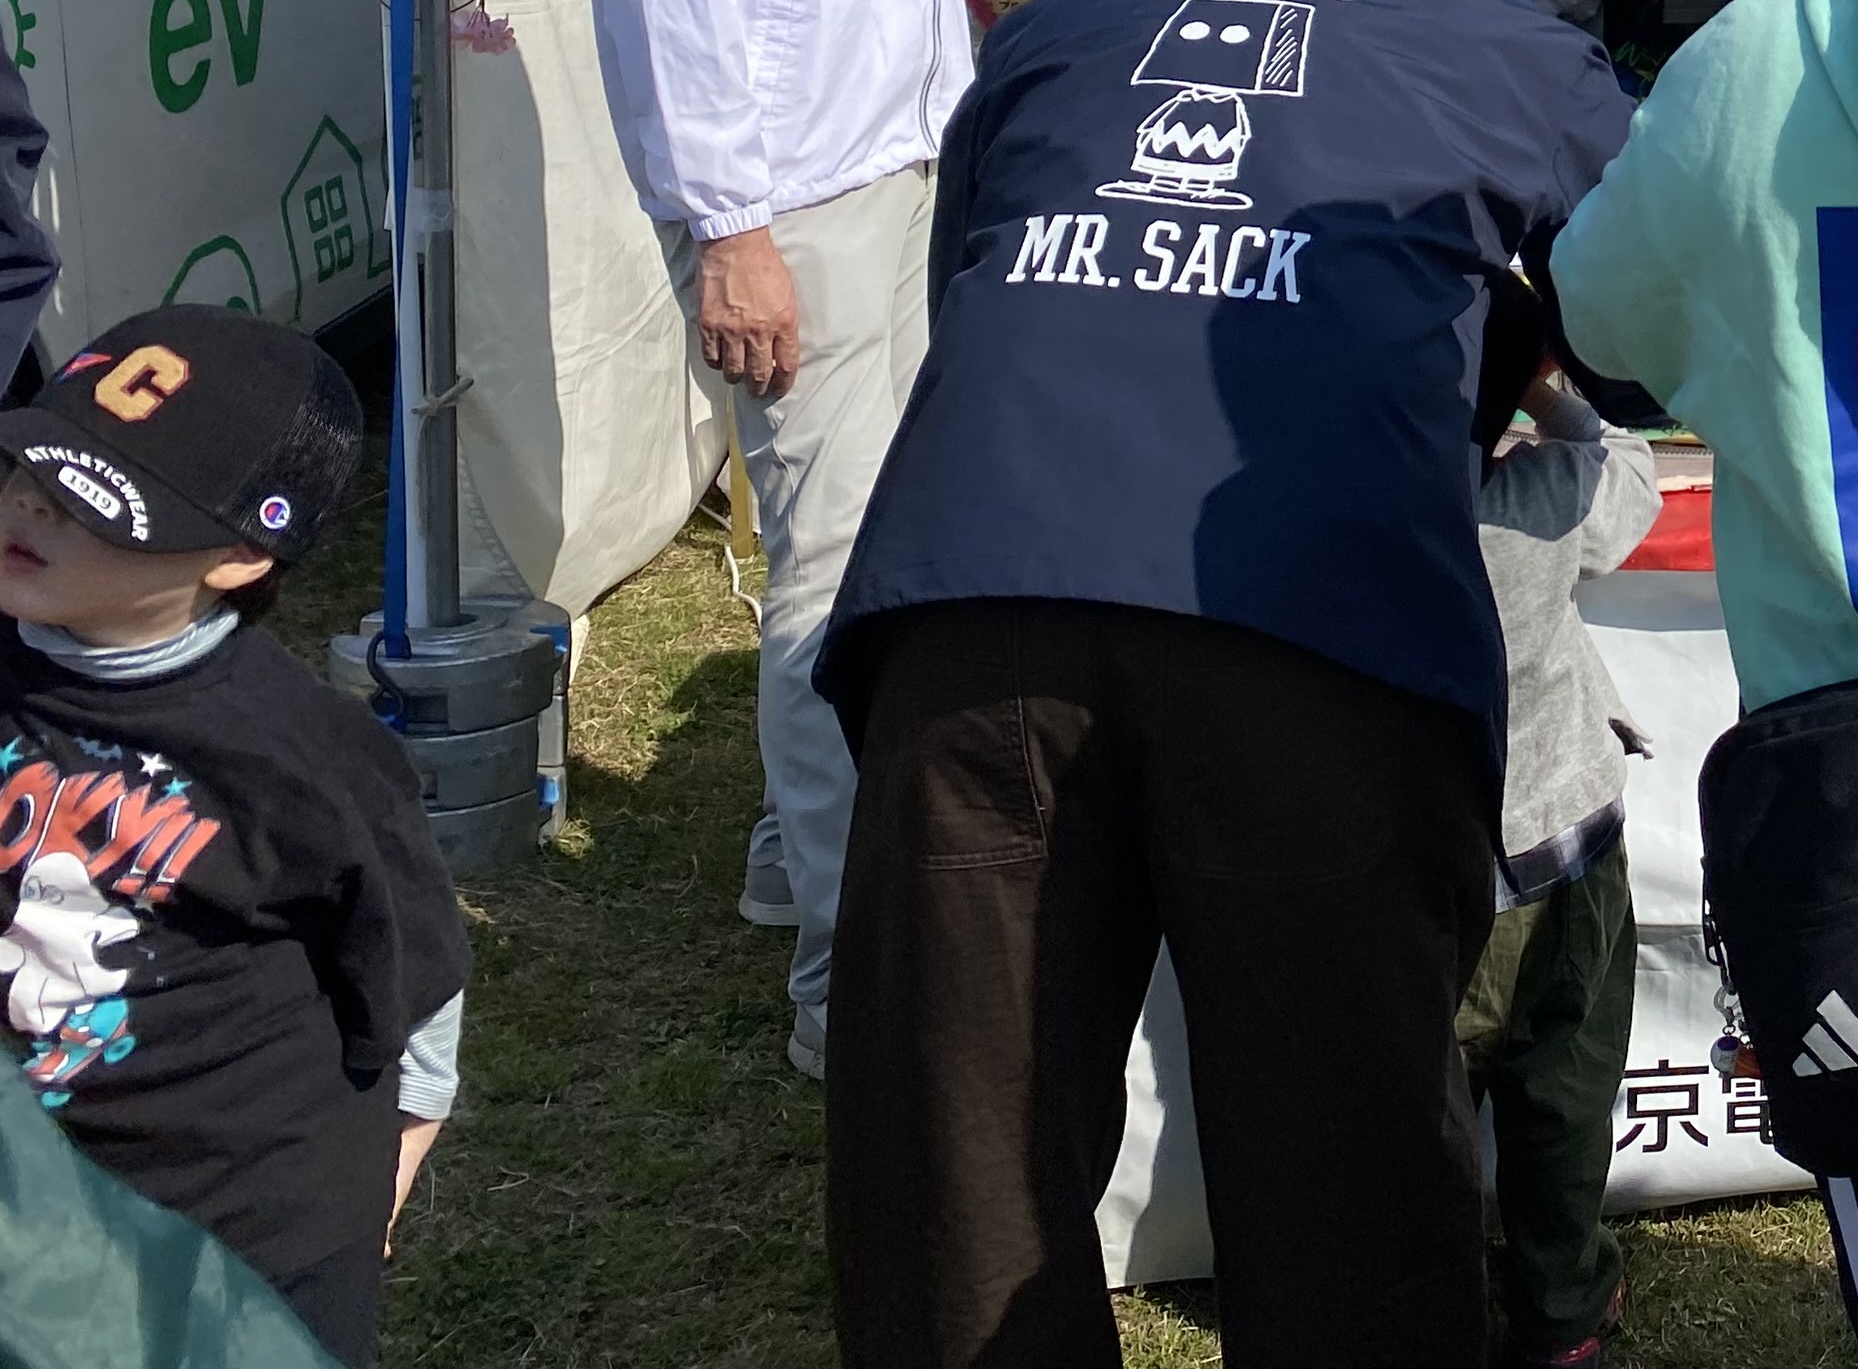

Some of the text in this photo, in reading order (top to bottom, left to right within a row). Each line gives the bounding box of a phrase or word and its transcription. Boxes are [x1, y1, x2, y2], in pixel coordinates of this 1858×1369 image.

[1006, 214, 1312, 303] MR. SACK
[94, 344, 190, 422] C
[24, 445, 150, 542] ATHLETICWEAR
[67, 473, 112, 511] 1919
